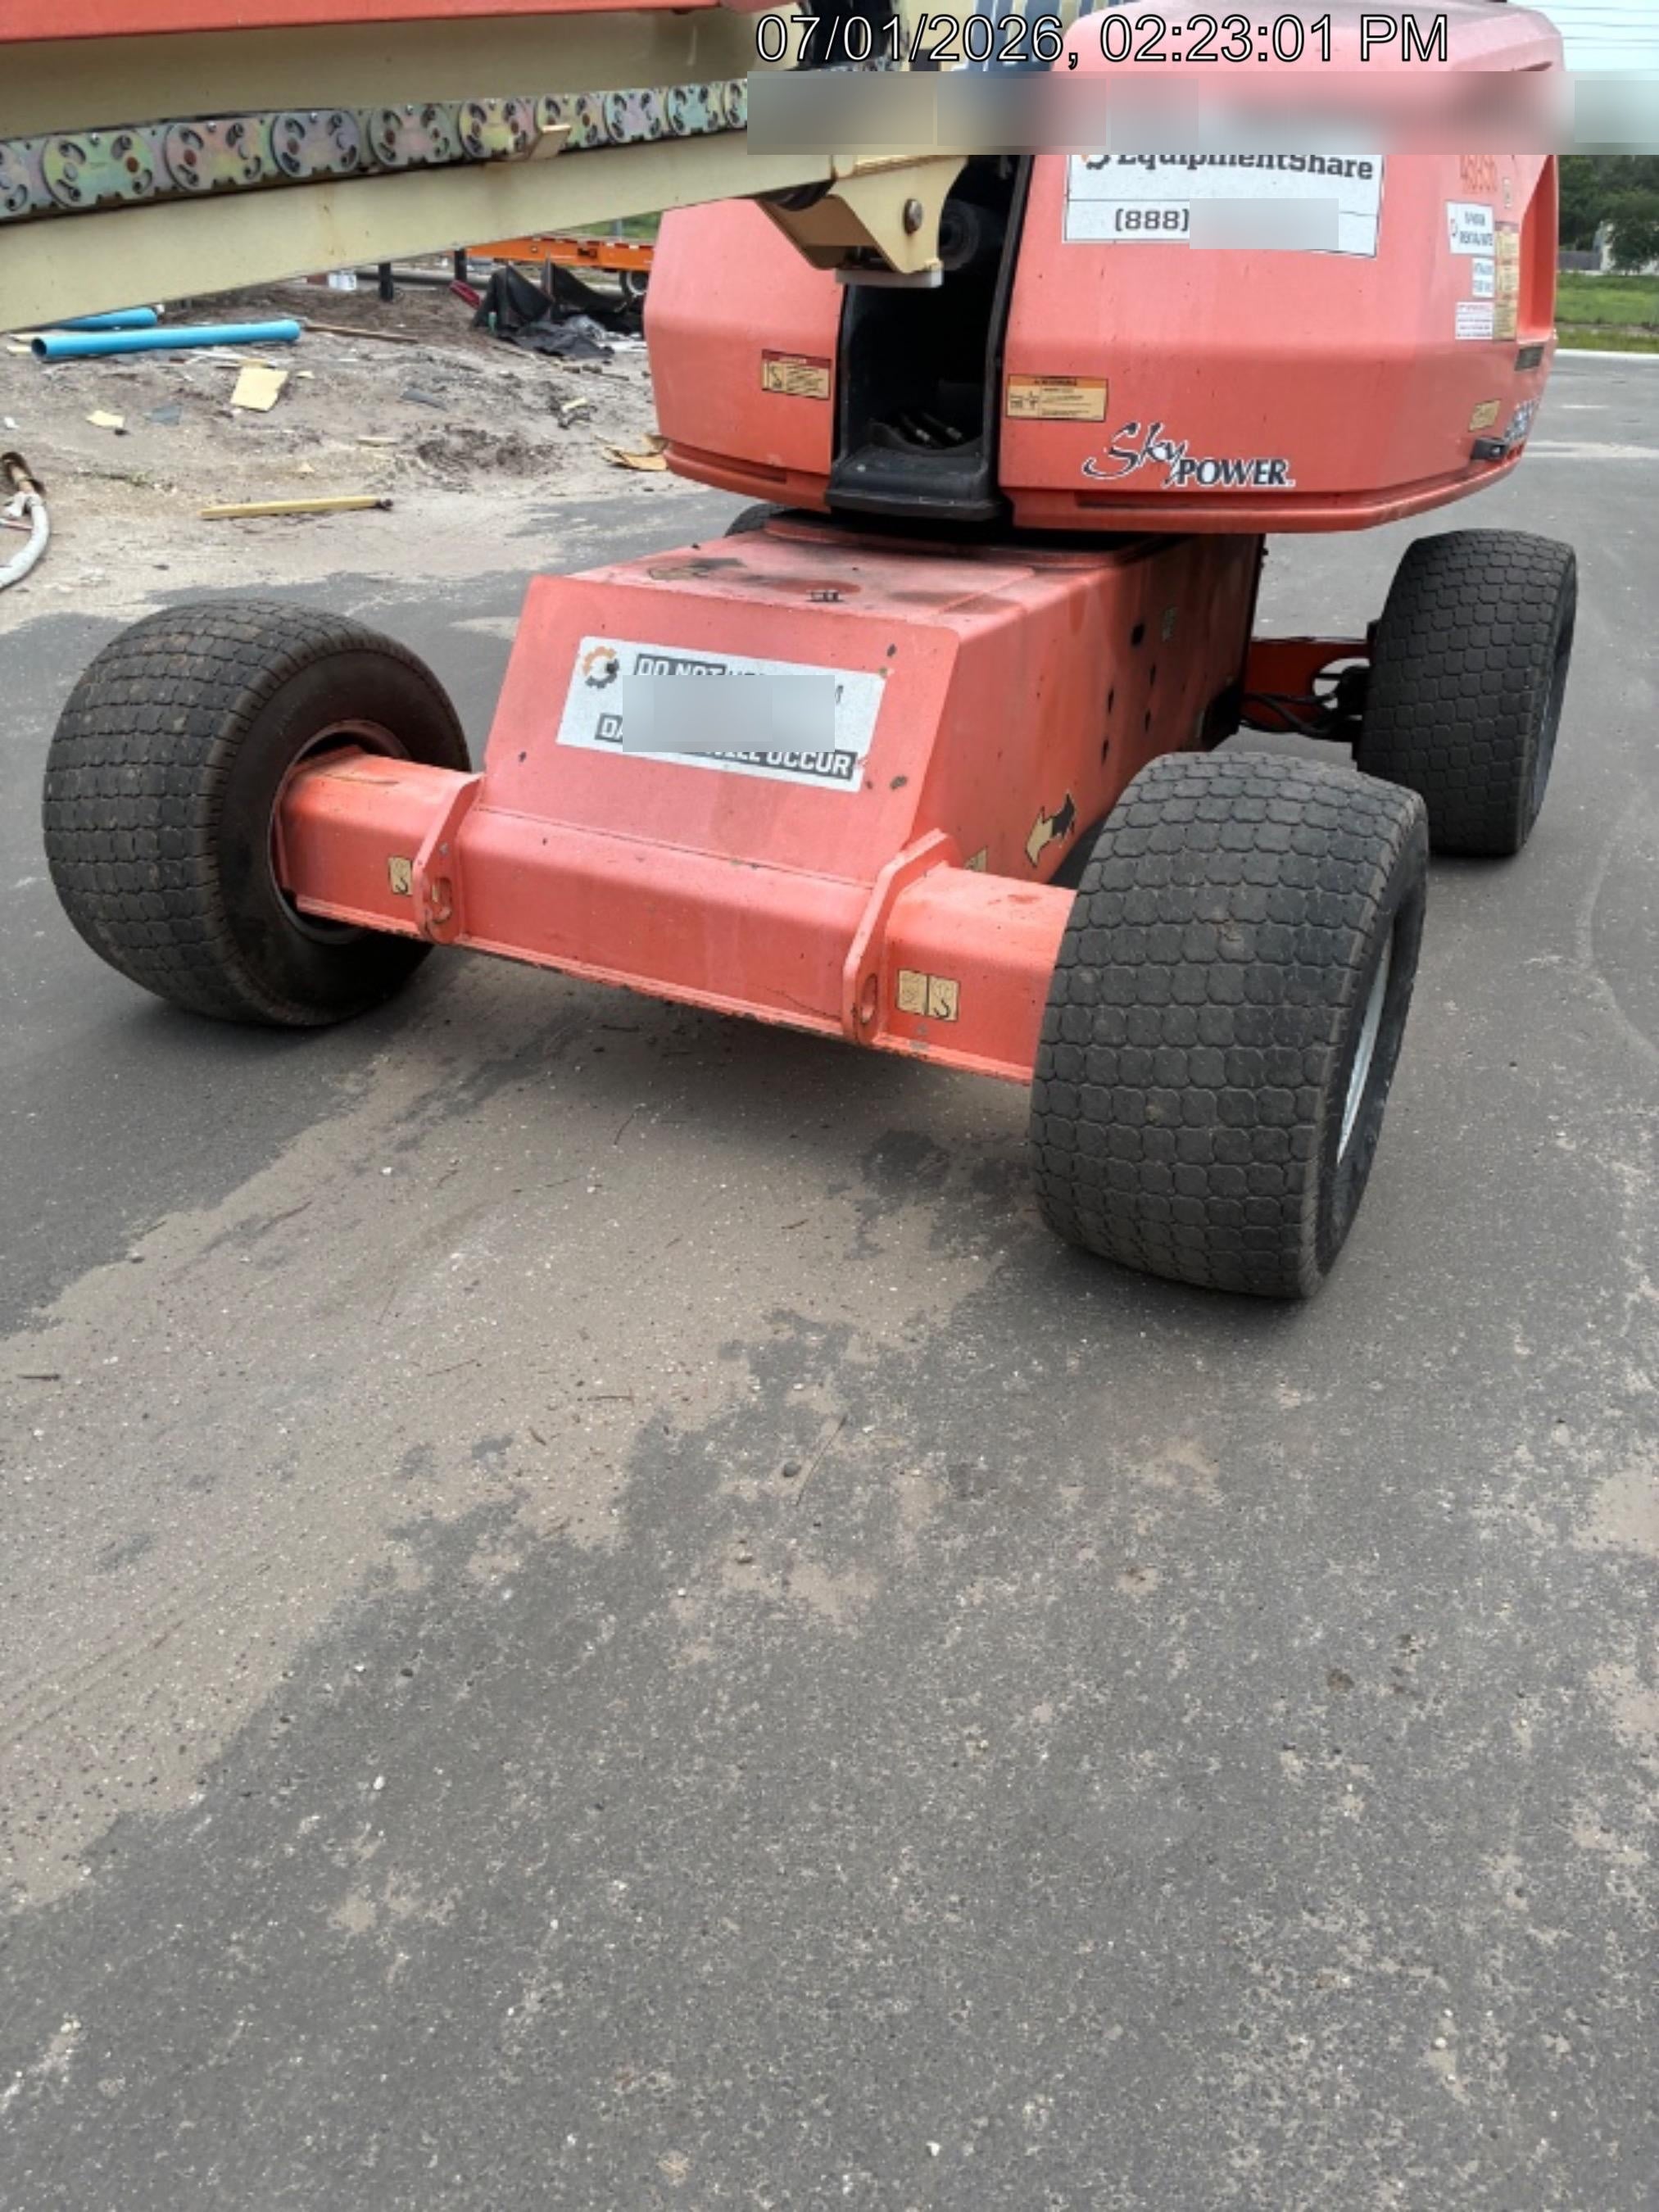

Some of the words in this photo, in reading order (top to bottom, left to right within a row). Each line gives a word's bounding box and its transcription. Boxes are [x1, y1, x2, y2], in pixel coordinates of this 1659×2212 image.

[1082, 422, 1187, 488] Sky
[1176, 458, 1289, 487] POWER
[765, 751, 851, 777] OCCUR
